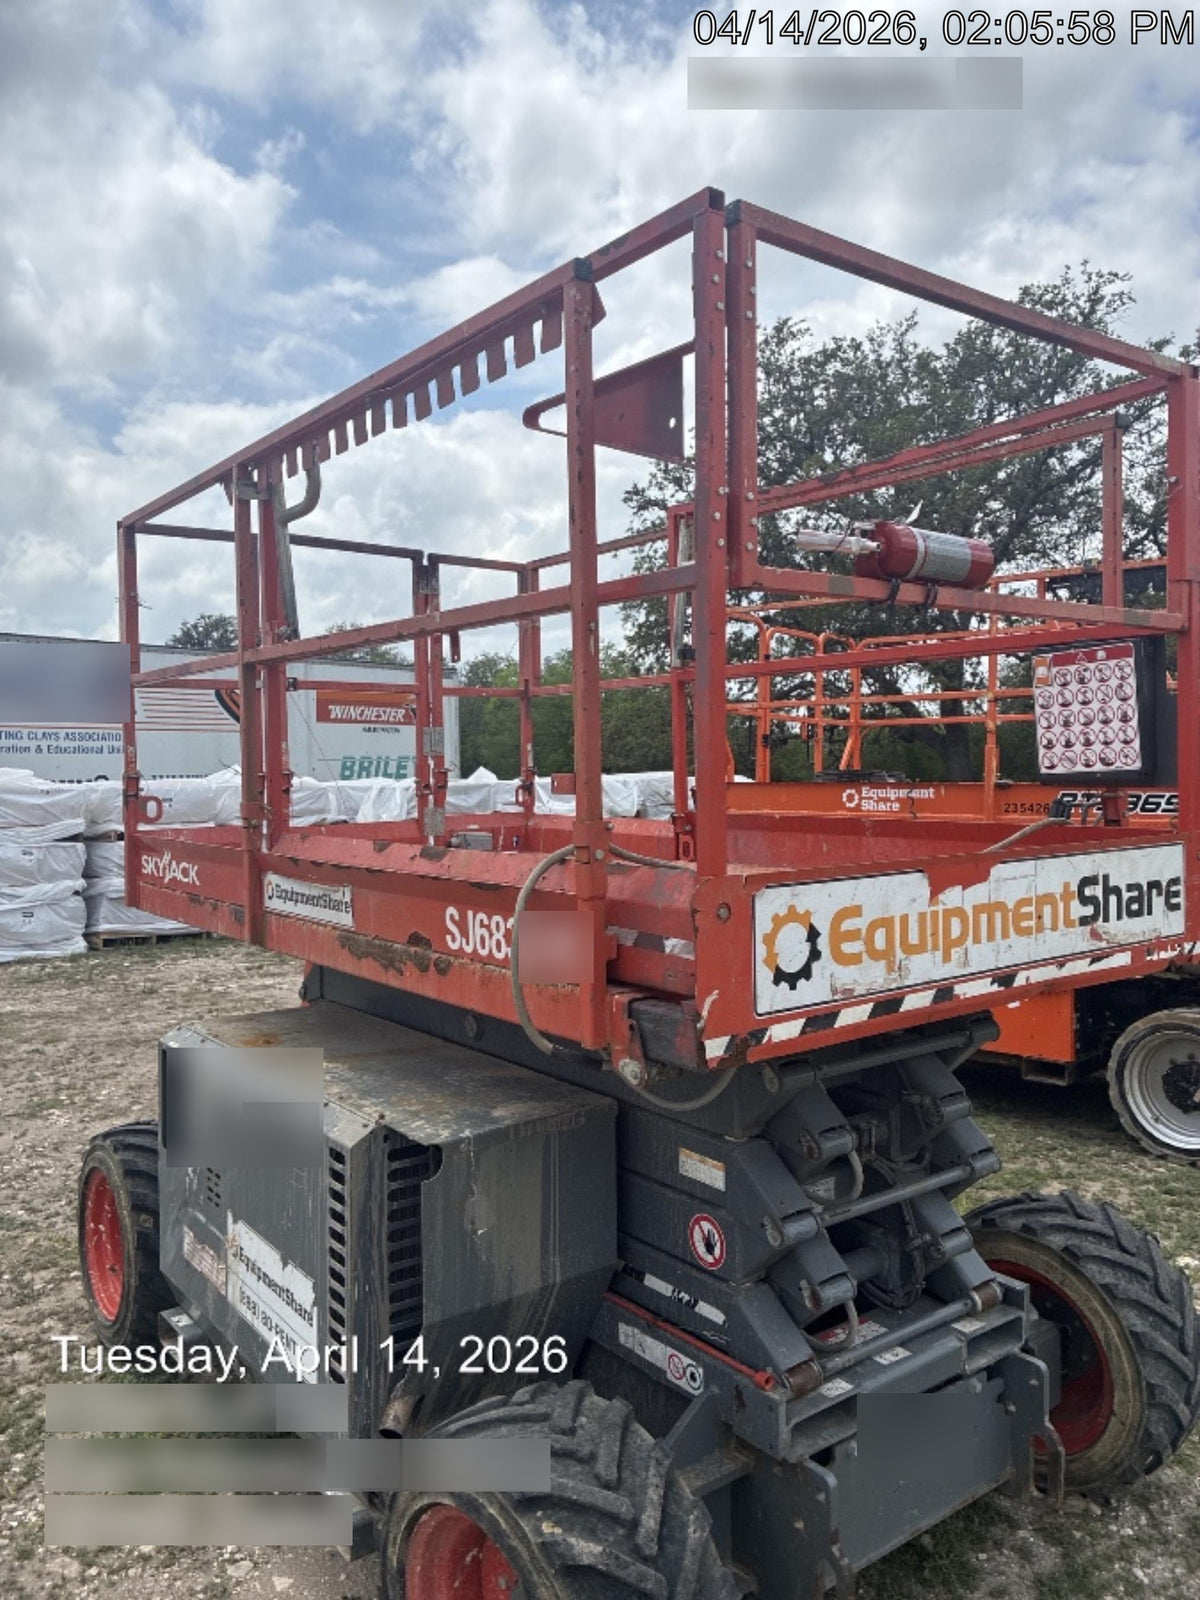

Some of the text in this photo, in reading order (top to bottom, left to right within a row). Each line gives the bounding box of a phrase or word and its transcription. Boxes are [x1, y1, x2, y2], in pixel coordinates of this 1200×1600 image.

[328, 705, 406, 722] WINCHESTER
[27, 731, 60, 741] CLAYS
[34, 745, 43, 754] &
[47, 745, 104, 755] Educational
[340, 756, 416, 780] BRILE
[861, 800, 900, 812] Share
[141, 849, 200, 886] SKYJACK
[275, 883, 351, 914] EquipmentShare
[445, 906, 515, 960] SJ68
[828, 873, 1182, 976] EquipmentShare
